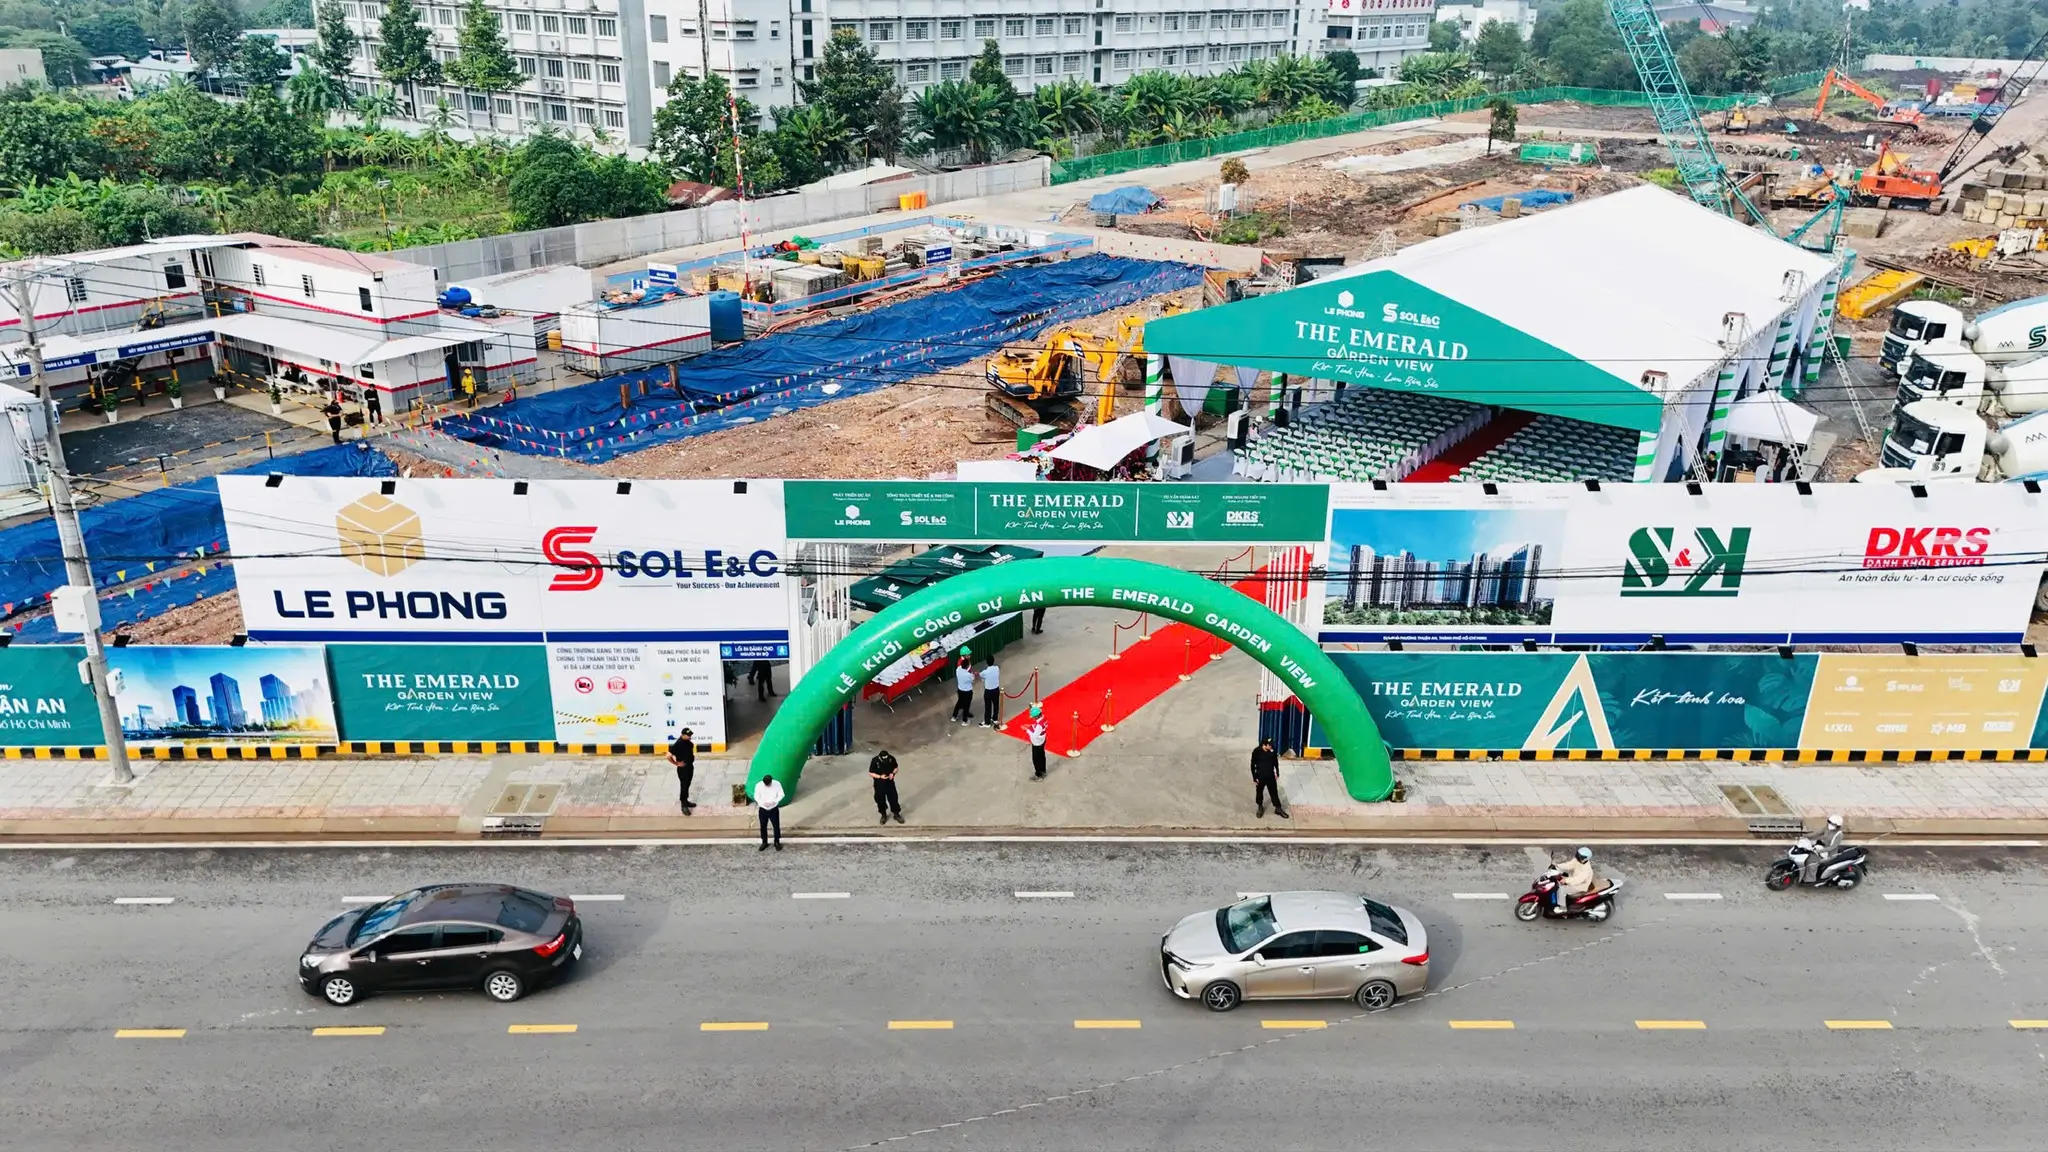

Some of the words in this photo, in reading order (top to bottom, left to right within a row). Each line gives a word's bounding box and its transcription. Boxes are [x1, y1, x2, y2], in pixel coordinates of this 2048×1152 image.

[1336, 308, 1365, 319] PHONG
[1400, 312, 1418, 322] SOL
[1421, 314, 1440, 325] E&C
[1296, 321, 1340, 343] THE
[1350, 328, 1468, 360] EMERALD
[1327, 344, 1388, 366] GARDEN
[1395, 360, 1434, 372] VIEW
[990, 495, 1026, 507] THE
[1034, 495, 1124, 507] EMERALD
[1018, 507, 1066, 518] GARDEN
[1227, 511, 1258, 520] DKRS
[1864, 527, 1991, 557] DKRS
[616, 550, 693, 578] SOL
[705, 550, 778, 578] E&C
[1866, 559, 1898, 567] DANH
[1902, 558, 1930, 567] KHÔI
[1855, 573, 1877, 582] toàn
[1904, 574, 1914, 582] tư
[1953, 574, 1978, 583] cuộc
[1979, 572, 2004, 584] sống
[273, 590, 334, 618] LE
[346, 591, 507, 619] PHONG
[836, 672, 857, 694] LỄ
[861, 640, 903, 672] KHỞI
[913, 610, 961, 639] CÔNG
[977, 596, 1002, 614] DỰ
[1018, 589, 1043, 605] ÁN
[1060, 587, 1095, 600] THE
[1112, 588, 1194, 615] EMERALD
[1205, 612, 1272, 654] GARDEN
[1279, 655, 1317, 690] VIEW
[362, 674, 406, 688] THE
[415, 675, 519, 688] EMERALD
[398, 688, 454, 700] GARDEN
[1371, 682, 1412, 696] THE
[1421, 682, 1522, 696] EMERALD
[1401, 695, 1455, 707] GARDEN
[1630, 688, 1678, 707] Kết
[1675, 691, 1710, 705] tinh
[1717, 691, 1745, 705] hoa
[36, 698, 66, 714] AN
[10, 720, 26, 729] Hồ
[28, 719, 45, 729] Chí
[47, 720, 71, 729] Minh
